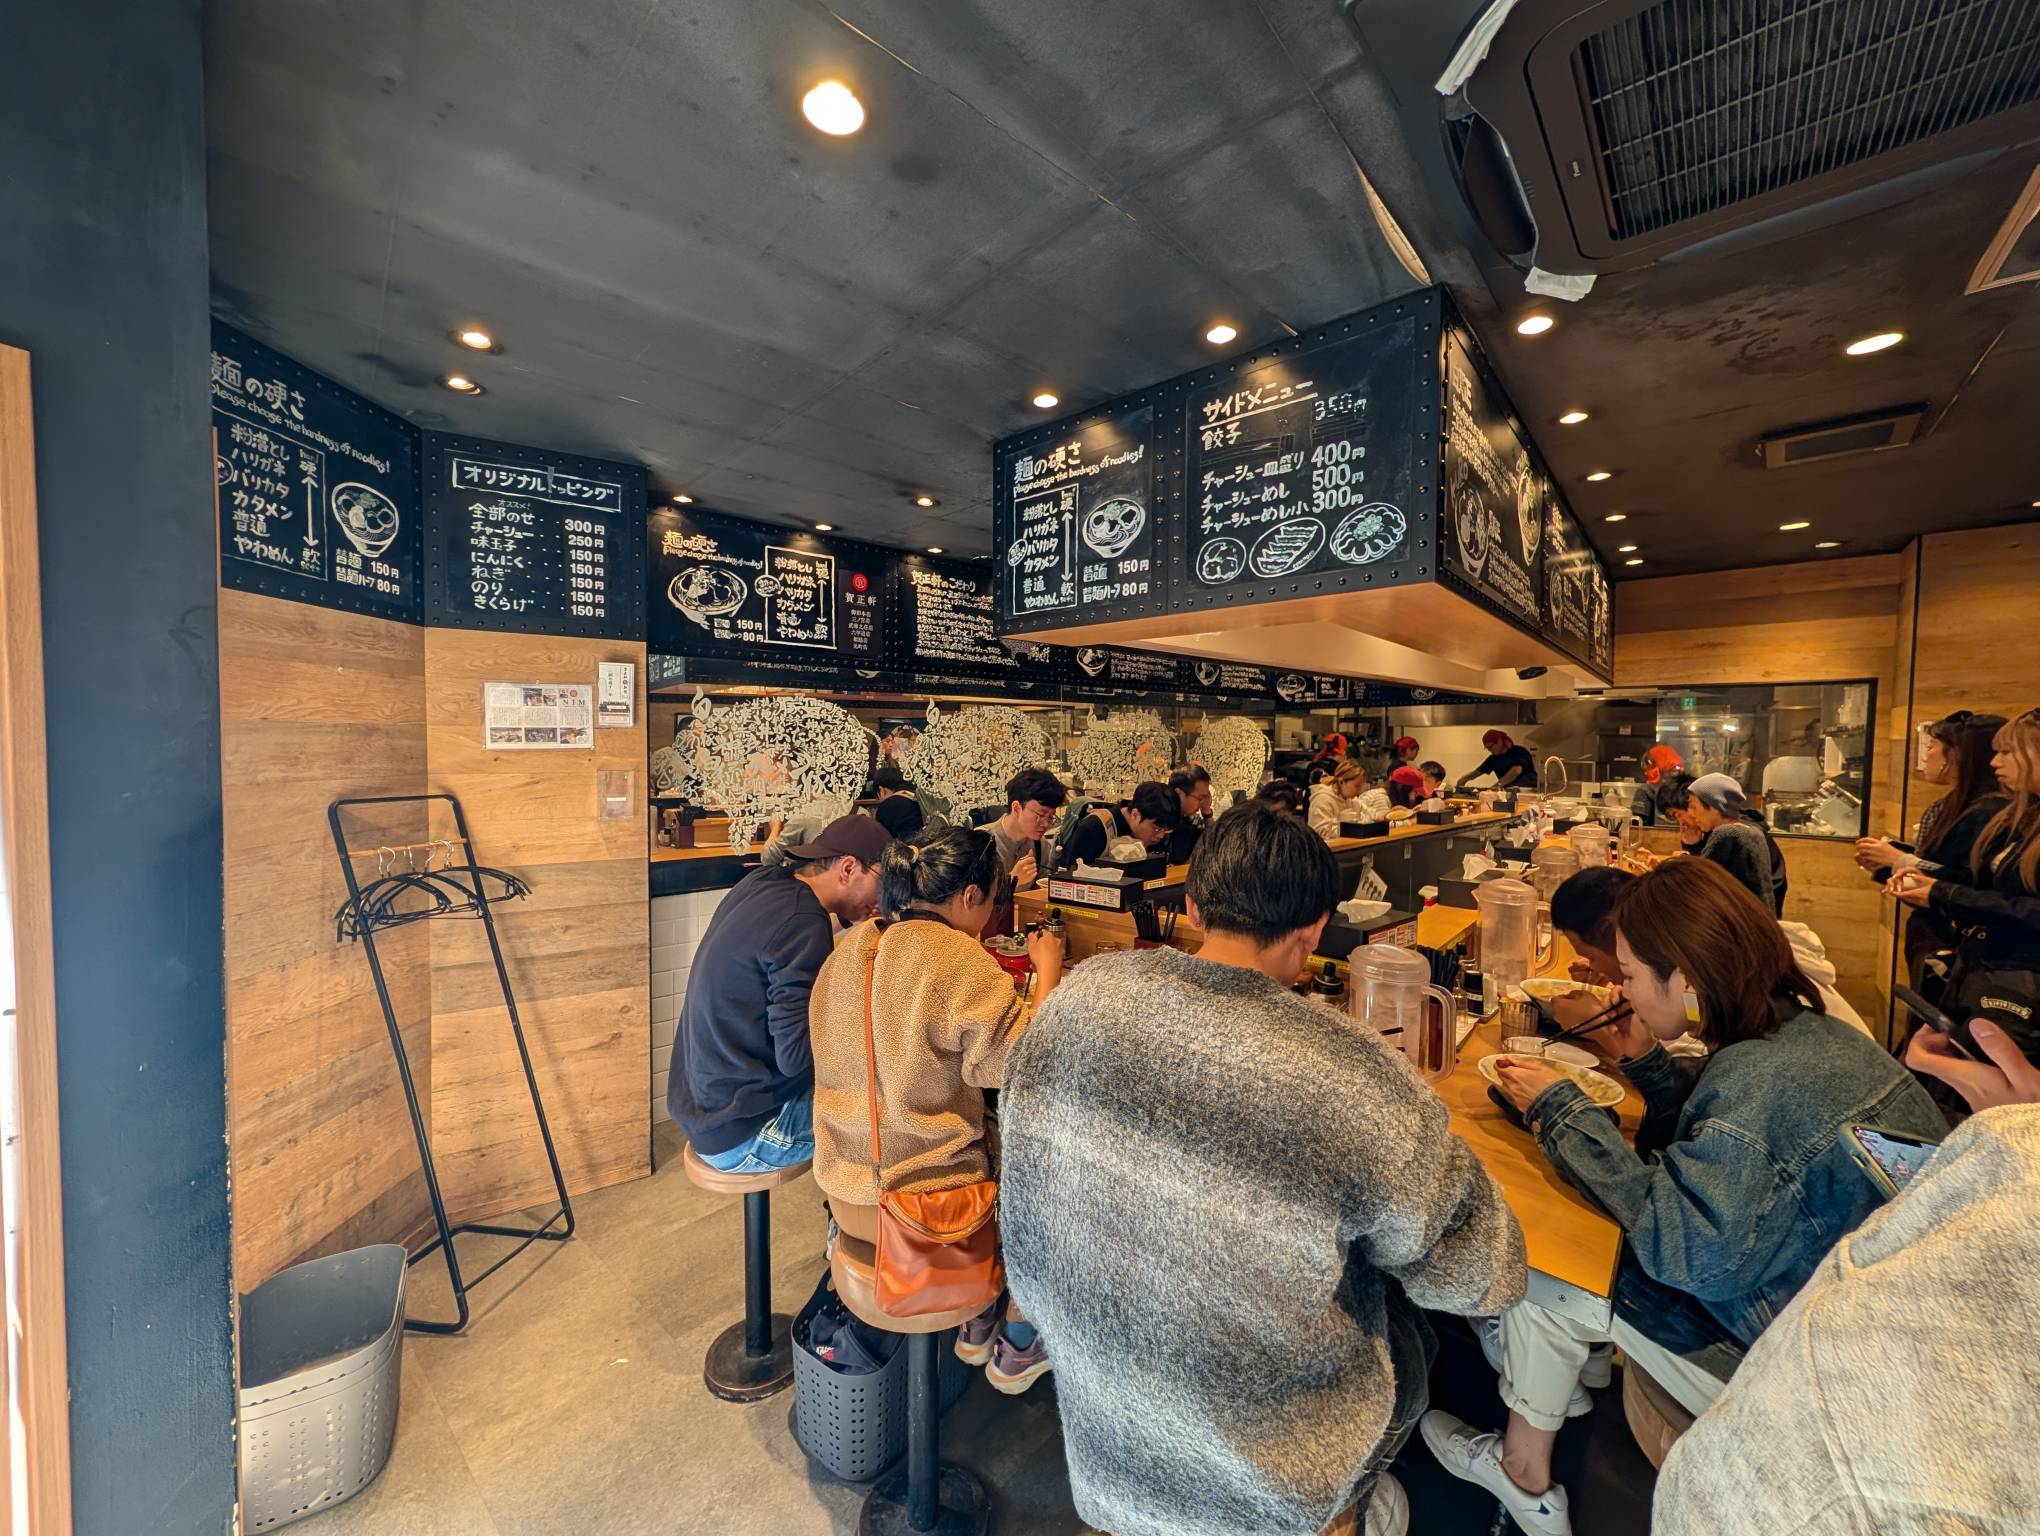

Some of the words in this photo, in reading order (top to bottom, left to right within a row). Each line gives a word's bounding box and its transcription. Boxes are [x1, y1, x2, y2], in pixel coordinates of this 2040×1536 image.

[1203, 381, 1314, 422] サイドメニュー
[284, 419, 301, 432] the
[1202, 422, 1242, 451] 餃子
[230, 423, 290, 461] 粉落とし
[231, 448, 286, 477] ハリガネ
[1014, 441, 1081, 484] 麺の硬さ
[1110, 444, 1145, 466] noodles!
[1202, 451, 1305, 491] チャーシュー皿盛り
[1311, 440, 1366, 467] 400円
[300, 460, 318, 478] 硬
[232, 469, 289, 499] バリカタ
[1201, 482, 1290, 516] チャーシューめし
[1312, 463, 1364, 491] 500円
[232, 489, 293, 520] カタメン
[1060, 498, 1074, 511] 硬
[1201, 500, 1309, 534] チャーシューめし小
[1312, 485, 1364, 513] 300円
[232, 510, 270, 537] 普通
[468, 502, 535, 525] 全部のせ
[564, 518, 605, 536] 300円
[1023, 516, 1059, 539] ハリガネ
[471, 521, 534, 539] チャーシュー
[568, 534, 604, 549] 250円
[1027, 537, 1059, 556] バリカタ
[233, 534, 294, 565] やわめん
[569, 549, 604, 563] 150円
[370, 560, 400, 579] 150円
[471, 551, 524, 568] にんにく
[569, 563, 604, 577] 150円
[1024, 555, 1060, 573] カタメン
[1118, 559, 1149, 575] 150円
[376, 579, 400, 596] 80円
[471, 565, 511, 581] ねぎ
[570, 577, 604, 590] 150円
[1023, 575, 1046, 594] 普通
[1060, 582, 1074, 596] 軟
[1122, 582, 1149, 597] 80円
[471, 580, 503, 595] のり
[570, 590, 605, 604] 150円
[1024, 592, 1059, 608] やわめん
[474, 594, 534, 612] きくらげ
[570, 604, 605, 618] 150円
[736, 619, 763, 631] 150円
[742, 632, 764, 642] 80円
